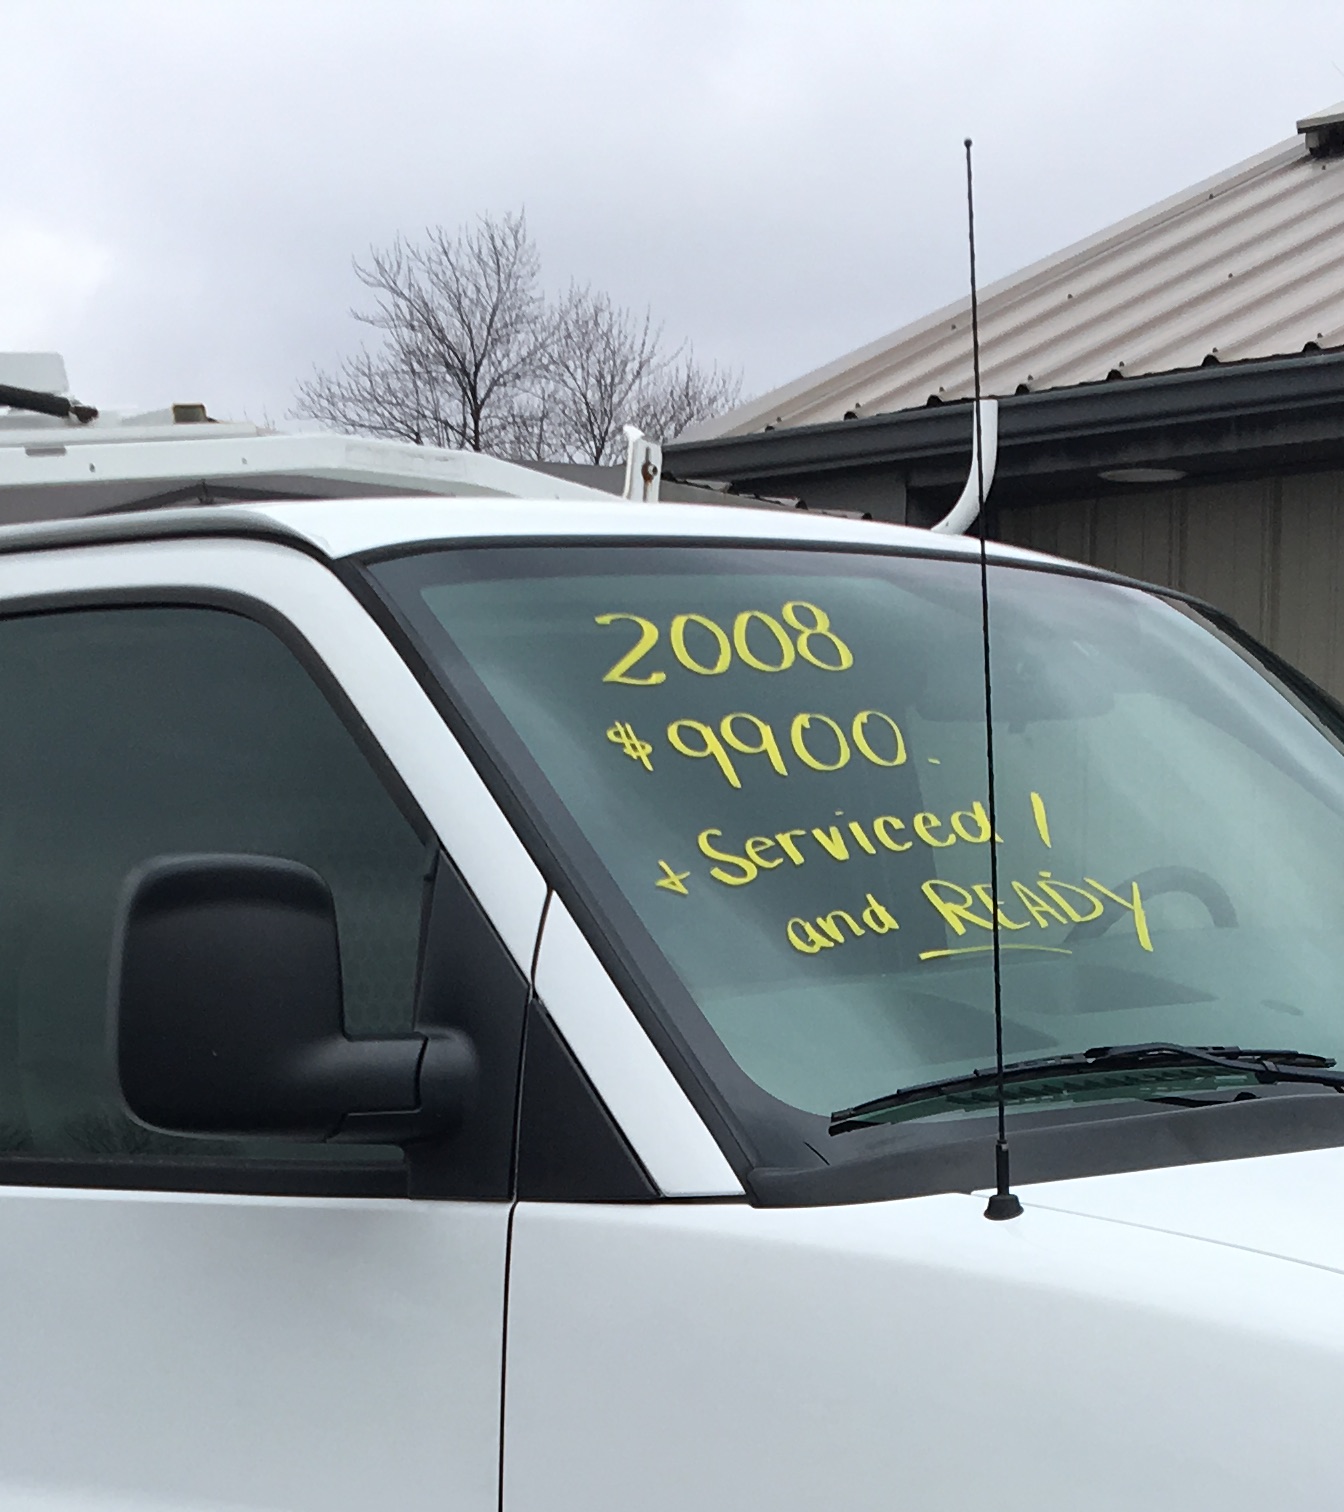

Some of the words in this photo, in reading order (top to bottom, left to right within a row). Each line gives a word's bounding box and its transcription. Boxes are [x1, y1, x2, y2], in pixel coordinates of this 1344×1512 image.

[596, 600, 854, 686] 2008
[786, 893, 900, 954] and
[920, 876, 1154, 953] READY
